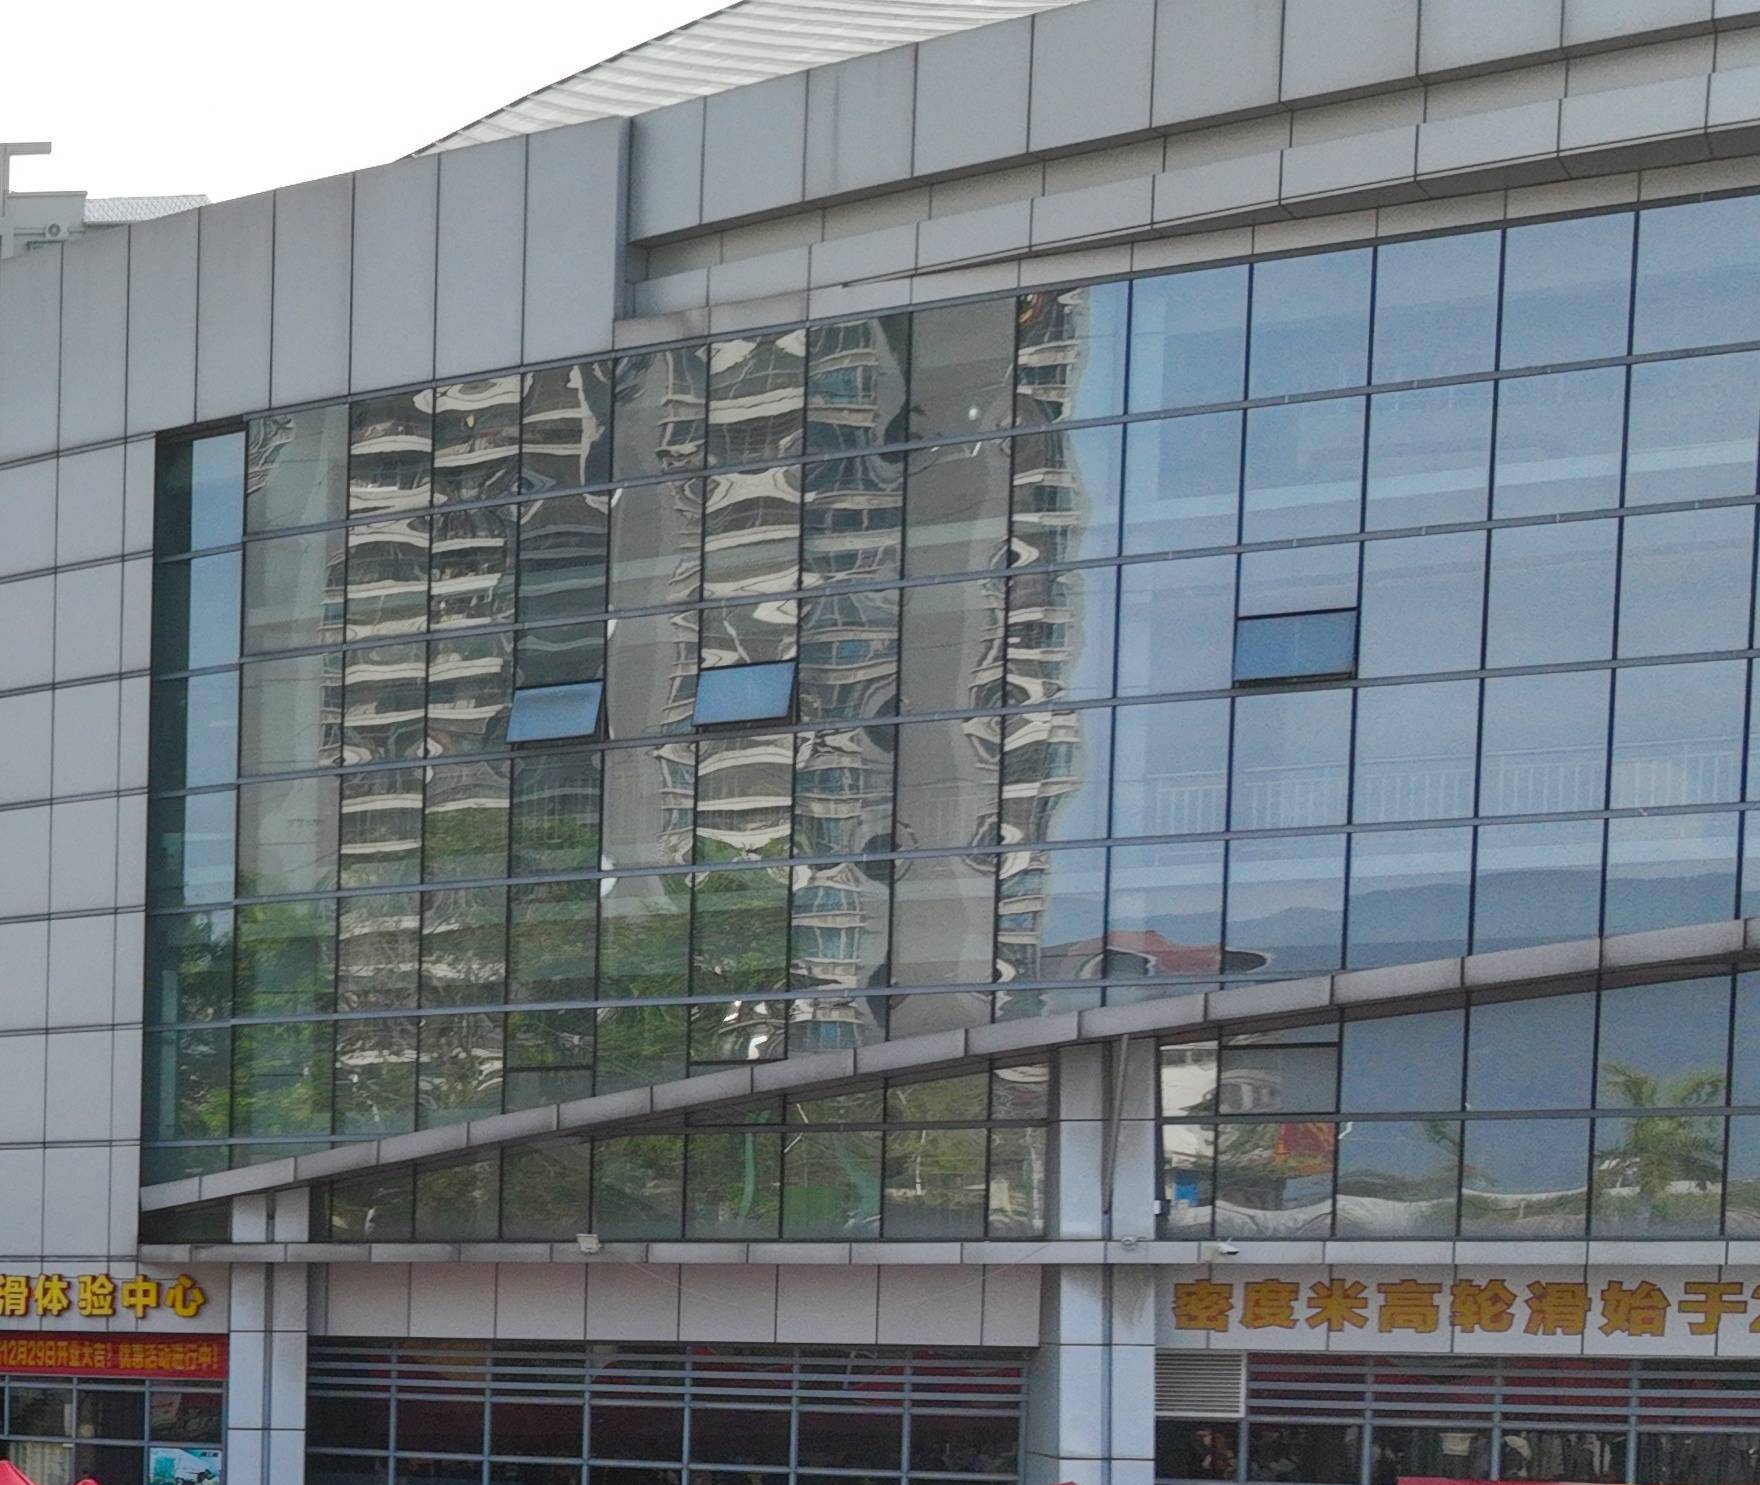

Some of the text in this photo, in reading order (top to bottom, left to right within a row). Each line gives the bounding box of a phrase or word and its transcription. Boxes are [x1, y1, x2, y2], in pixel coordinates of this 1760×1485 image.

[1172, 1278, 1760, 1337] 密度米高轮滑始于
